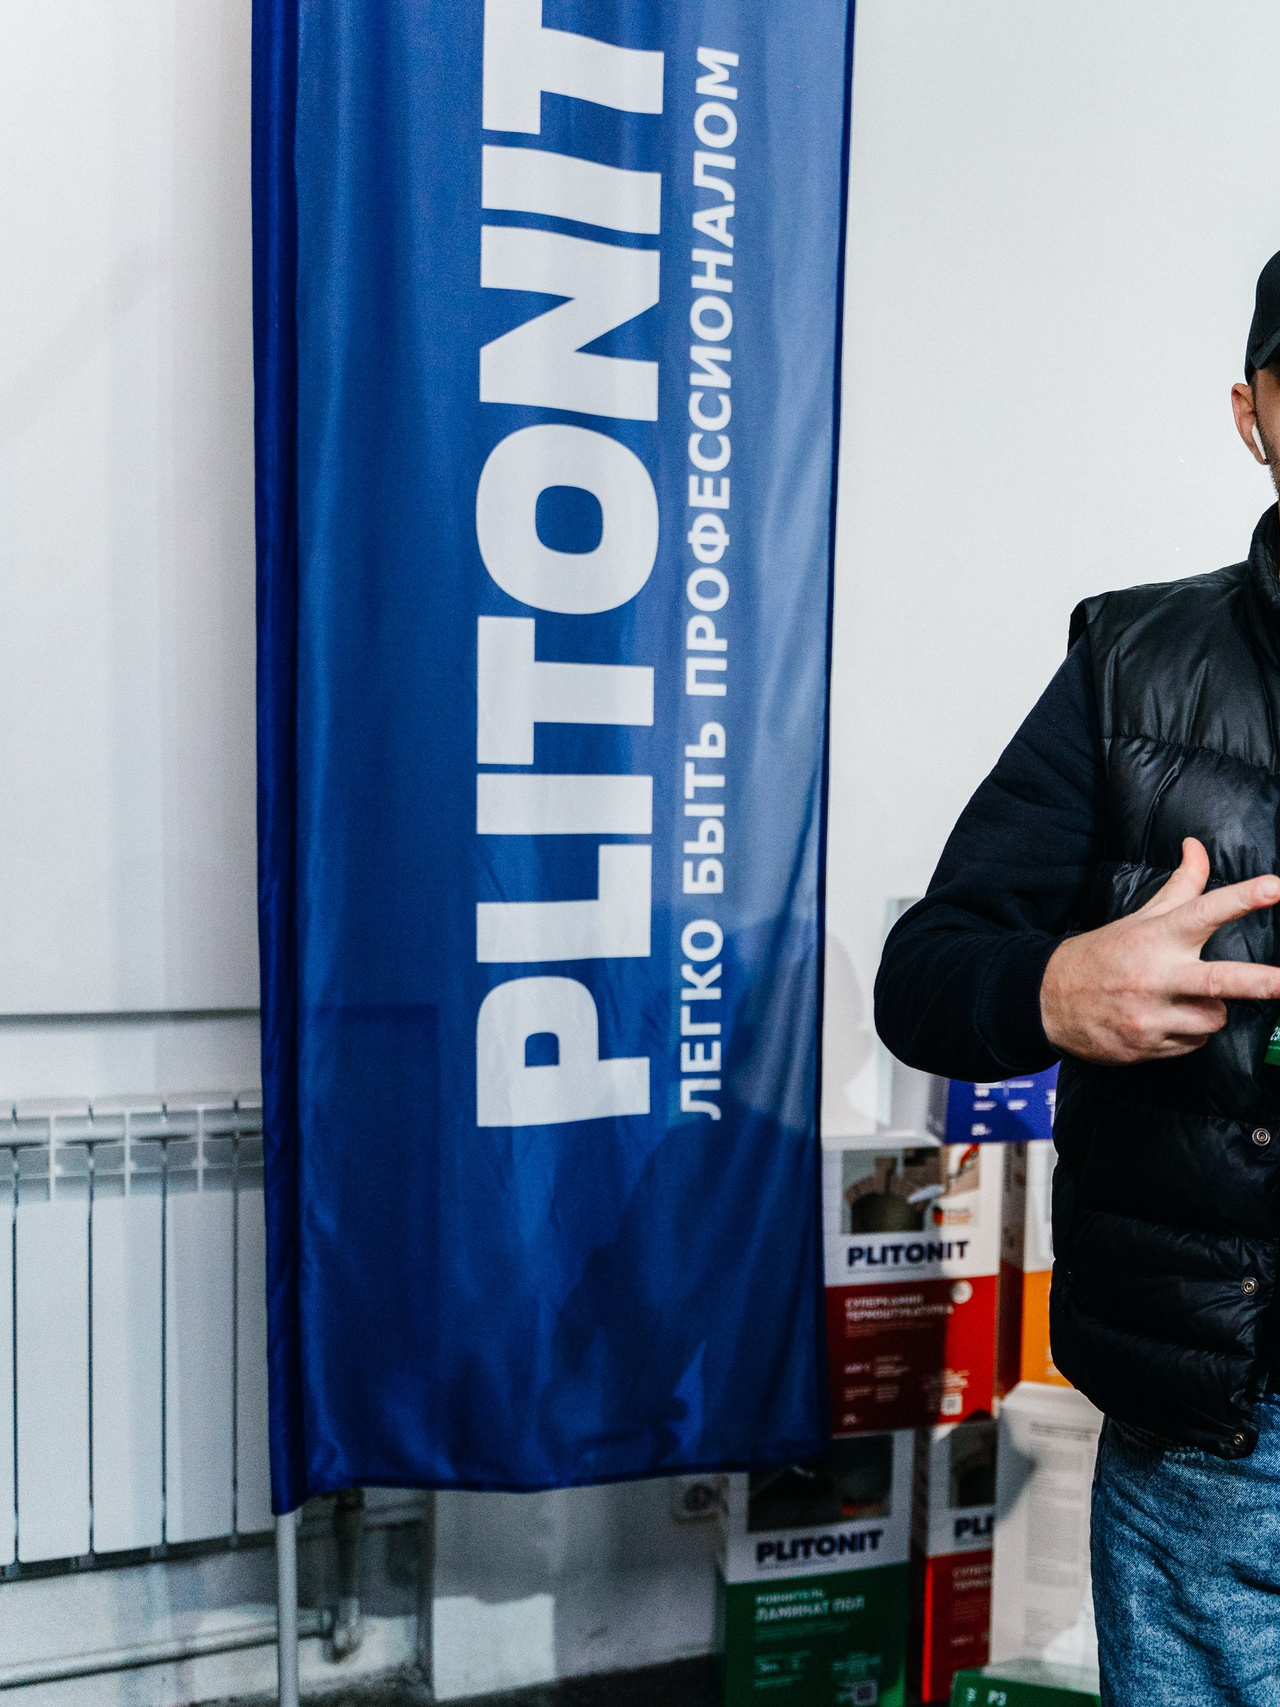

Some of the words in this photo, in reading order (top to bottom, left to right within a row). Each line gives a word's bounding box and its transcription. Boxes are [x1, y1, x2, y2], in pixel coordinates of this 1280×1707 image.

[686, 45, 740, 697] ПРОФЕССИОНАЛОМ
[476, 0, 665, 1127] PLITONIT
[683, 722, 726, 895] БЫТЬ
[680, 919, 724, 1121] ЛЕГКО
[846, 1240, 969, 1266] PLITONIT
[756, 1529, 884, 1564] PLITONIT
